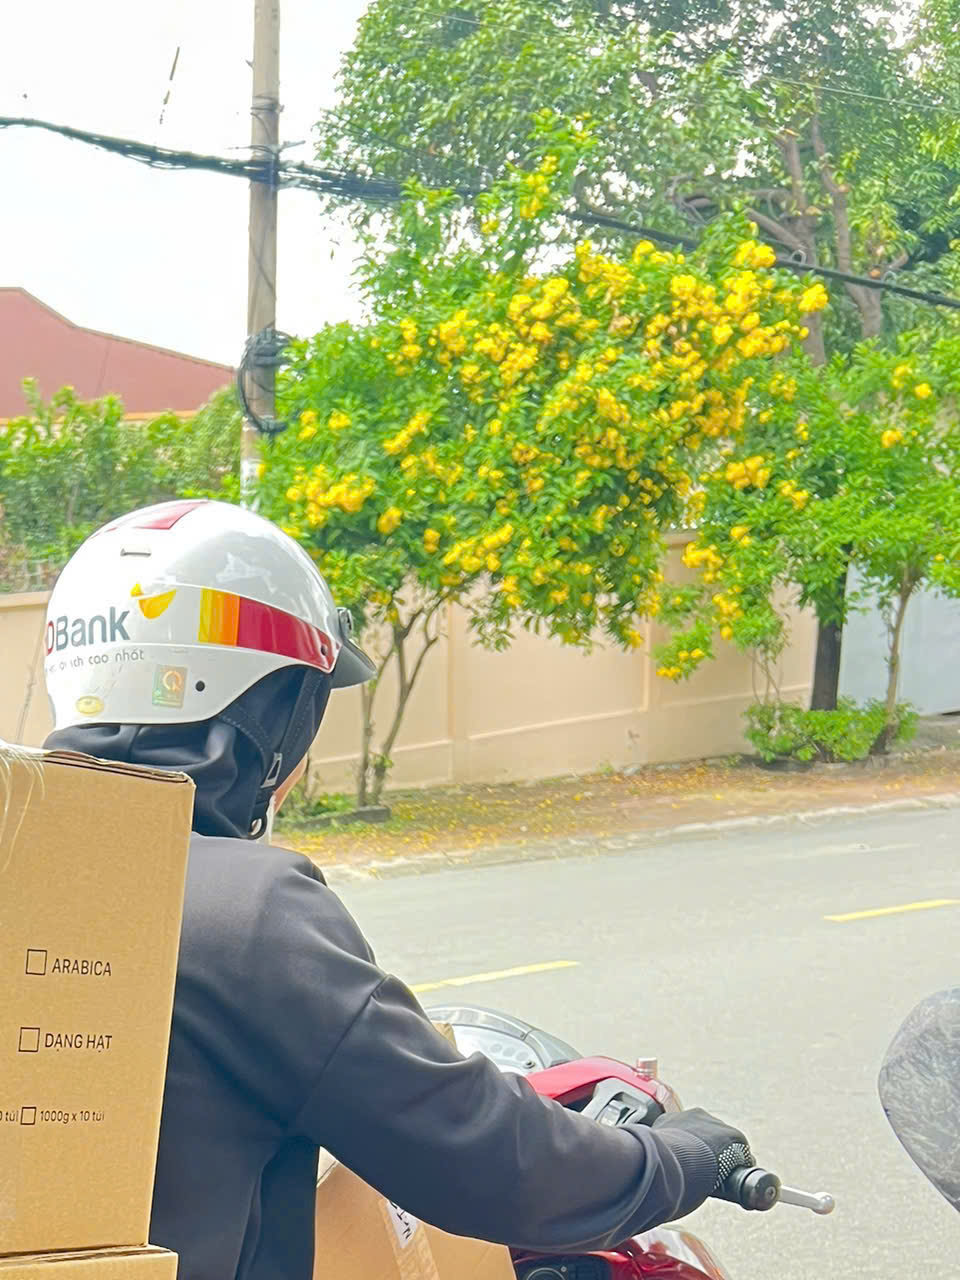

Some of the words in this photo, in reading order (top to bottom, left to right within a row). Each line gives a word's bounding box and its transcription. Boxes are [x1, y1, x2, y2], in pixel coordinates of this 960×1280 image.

[88, 654, 109, 665] cao
[51, 958, 112, 977] ARABICA
[44, 1033, 83, 1052] DẠNG
[86, 1034, 113, 1053] HẠT
[6, 1109, 19, 1122] túi
[40, 1110, 70, 1125] 1000g
[71, 1113, 77, 1122] x
[80, 1110, 90, 1122] 10
[91, 1109, 105, 1122] túi
